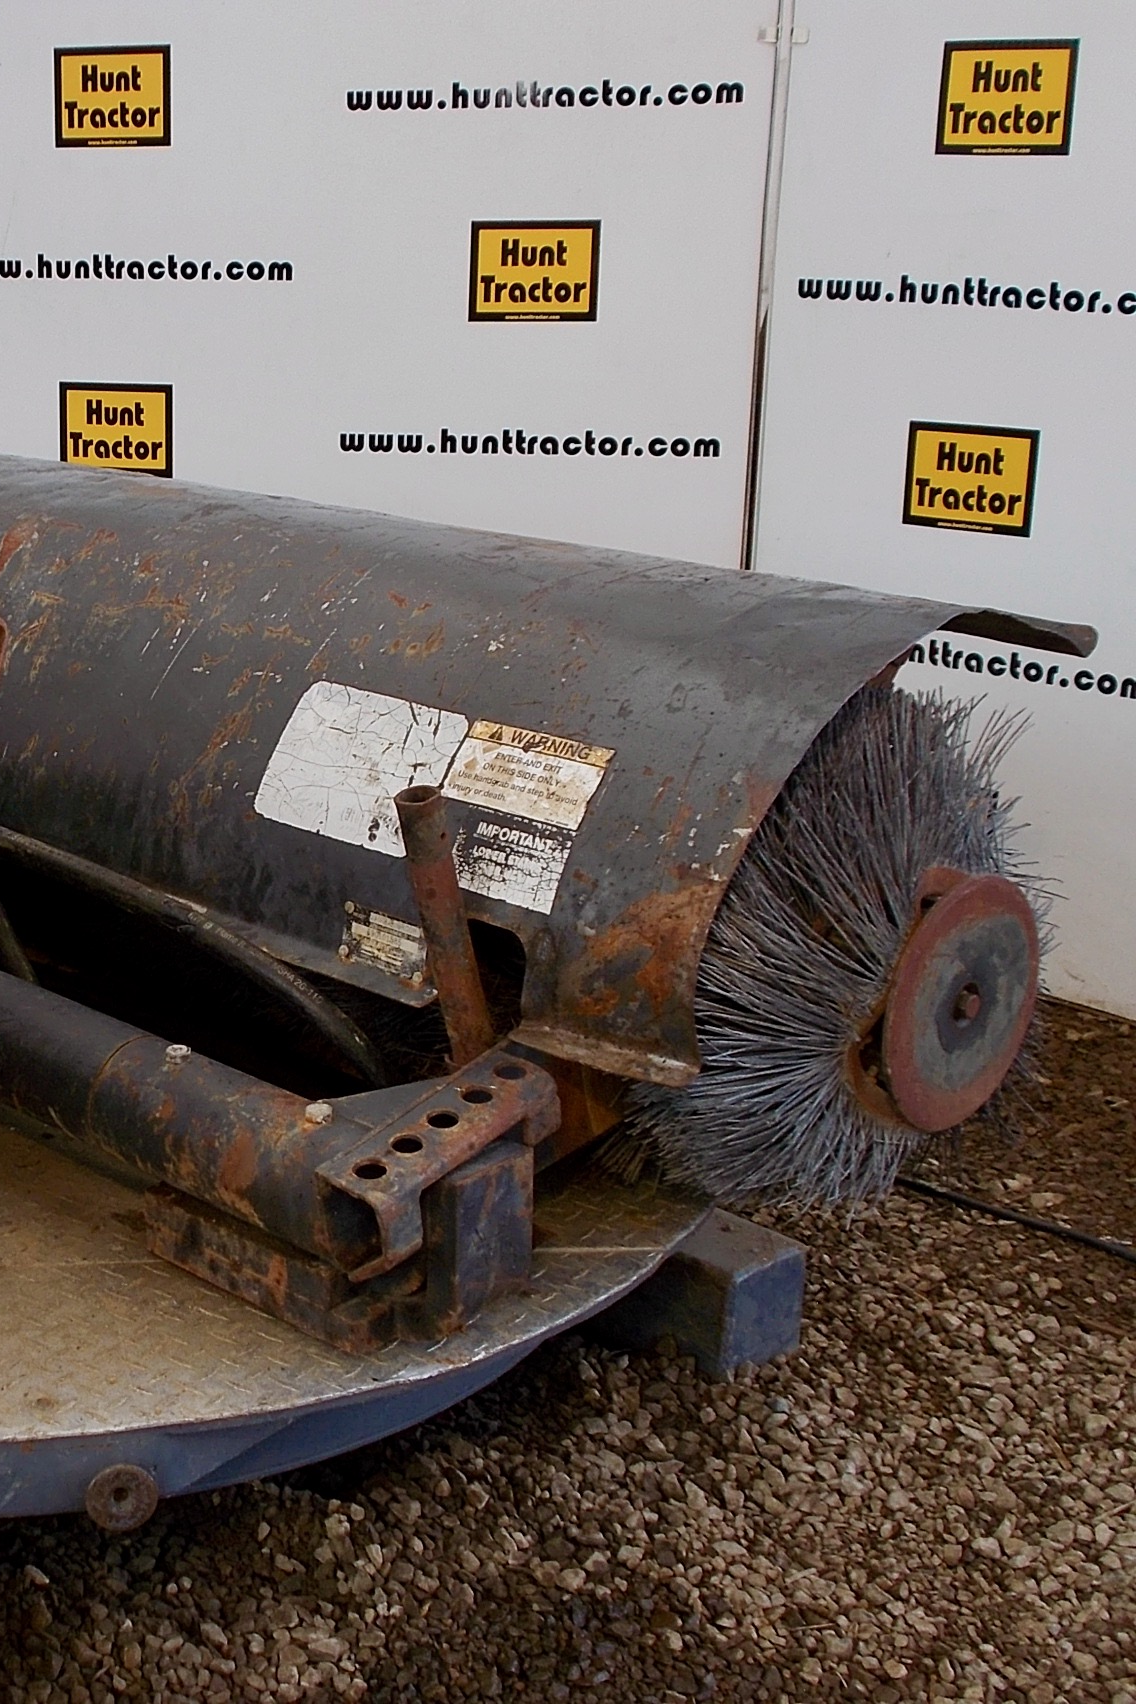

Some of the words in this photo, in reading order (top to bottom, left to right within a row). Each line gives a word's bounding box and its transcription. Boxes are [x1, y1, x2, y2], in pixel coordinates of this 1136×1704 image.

[82, 64, 141, 92] Hunt
[972, 61, 1042, 92] Hunt
[347, 79, 743, 111] www.hunttractor.com
[65, 101, 161, 129] Tractor
[949, 103, 1061, 134] Tractor
[501, 238, 568, 267] Hunt
[481, 276, 586, 303] Tractor
[86, 398, 144, 426] Hunt
[69, 431, 163, 460] Tractor
[339, 428, 721, 458] www.hunttractor.com
[936, 441, 1005, 476] Hunt
[915, 477, 1022, 516] Tractor
[510, 729, 592, 760] WARNING
[482, 762, 496, 772] ON
[497, 765, 516, 777] THIS
[516, 770, 536, 782] SIDE
[495, 752, 524, 766] ENTER
[523, 758, 543, 769] AND
[543, 762, 563, 774] EXIT
[452, 781, 472, 797] injury
[473, 787, 482, 796] or
[458, 769, 473, 780] Use
[473, 773, 509, 790] handgrab
[511, 781, 526, 793] and
[526, 785, 545, 799] step
[555, 792, 578, 806] avoid
[476, 821, 553, 851] IMPORTANT
